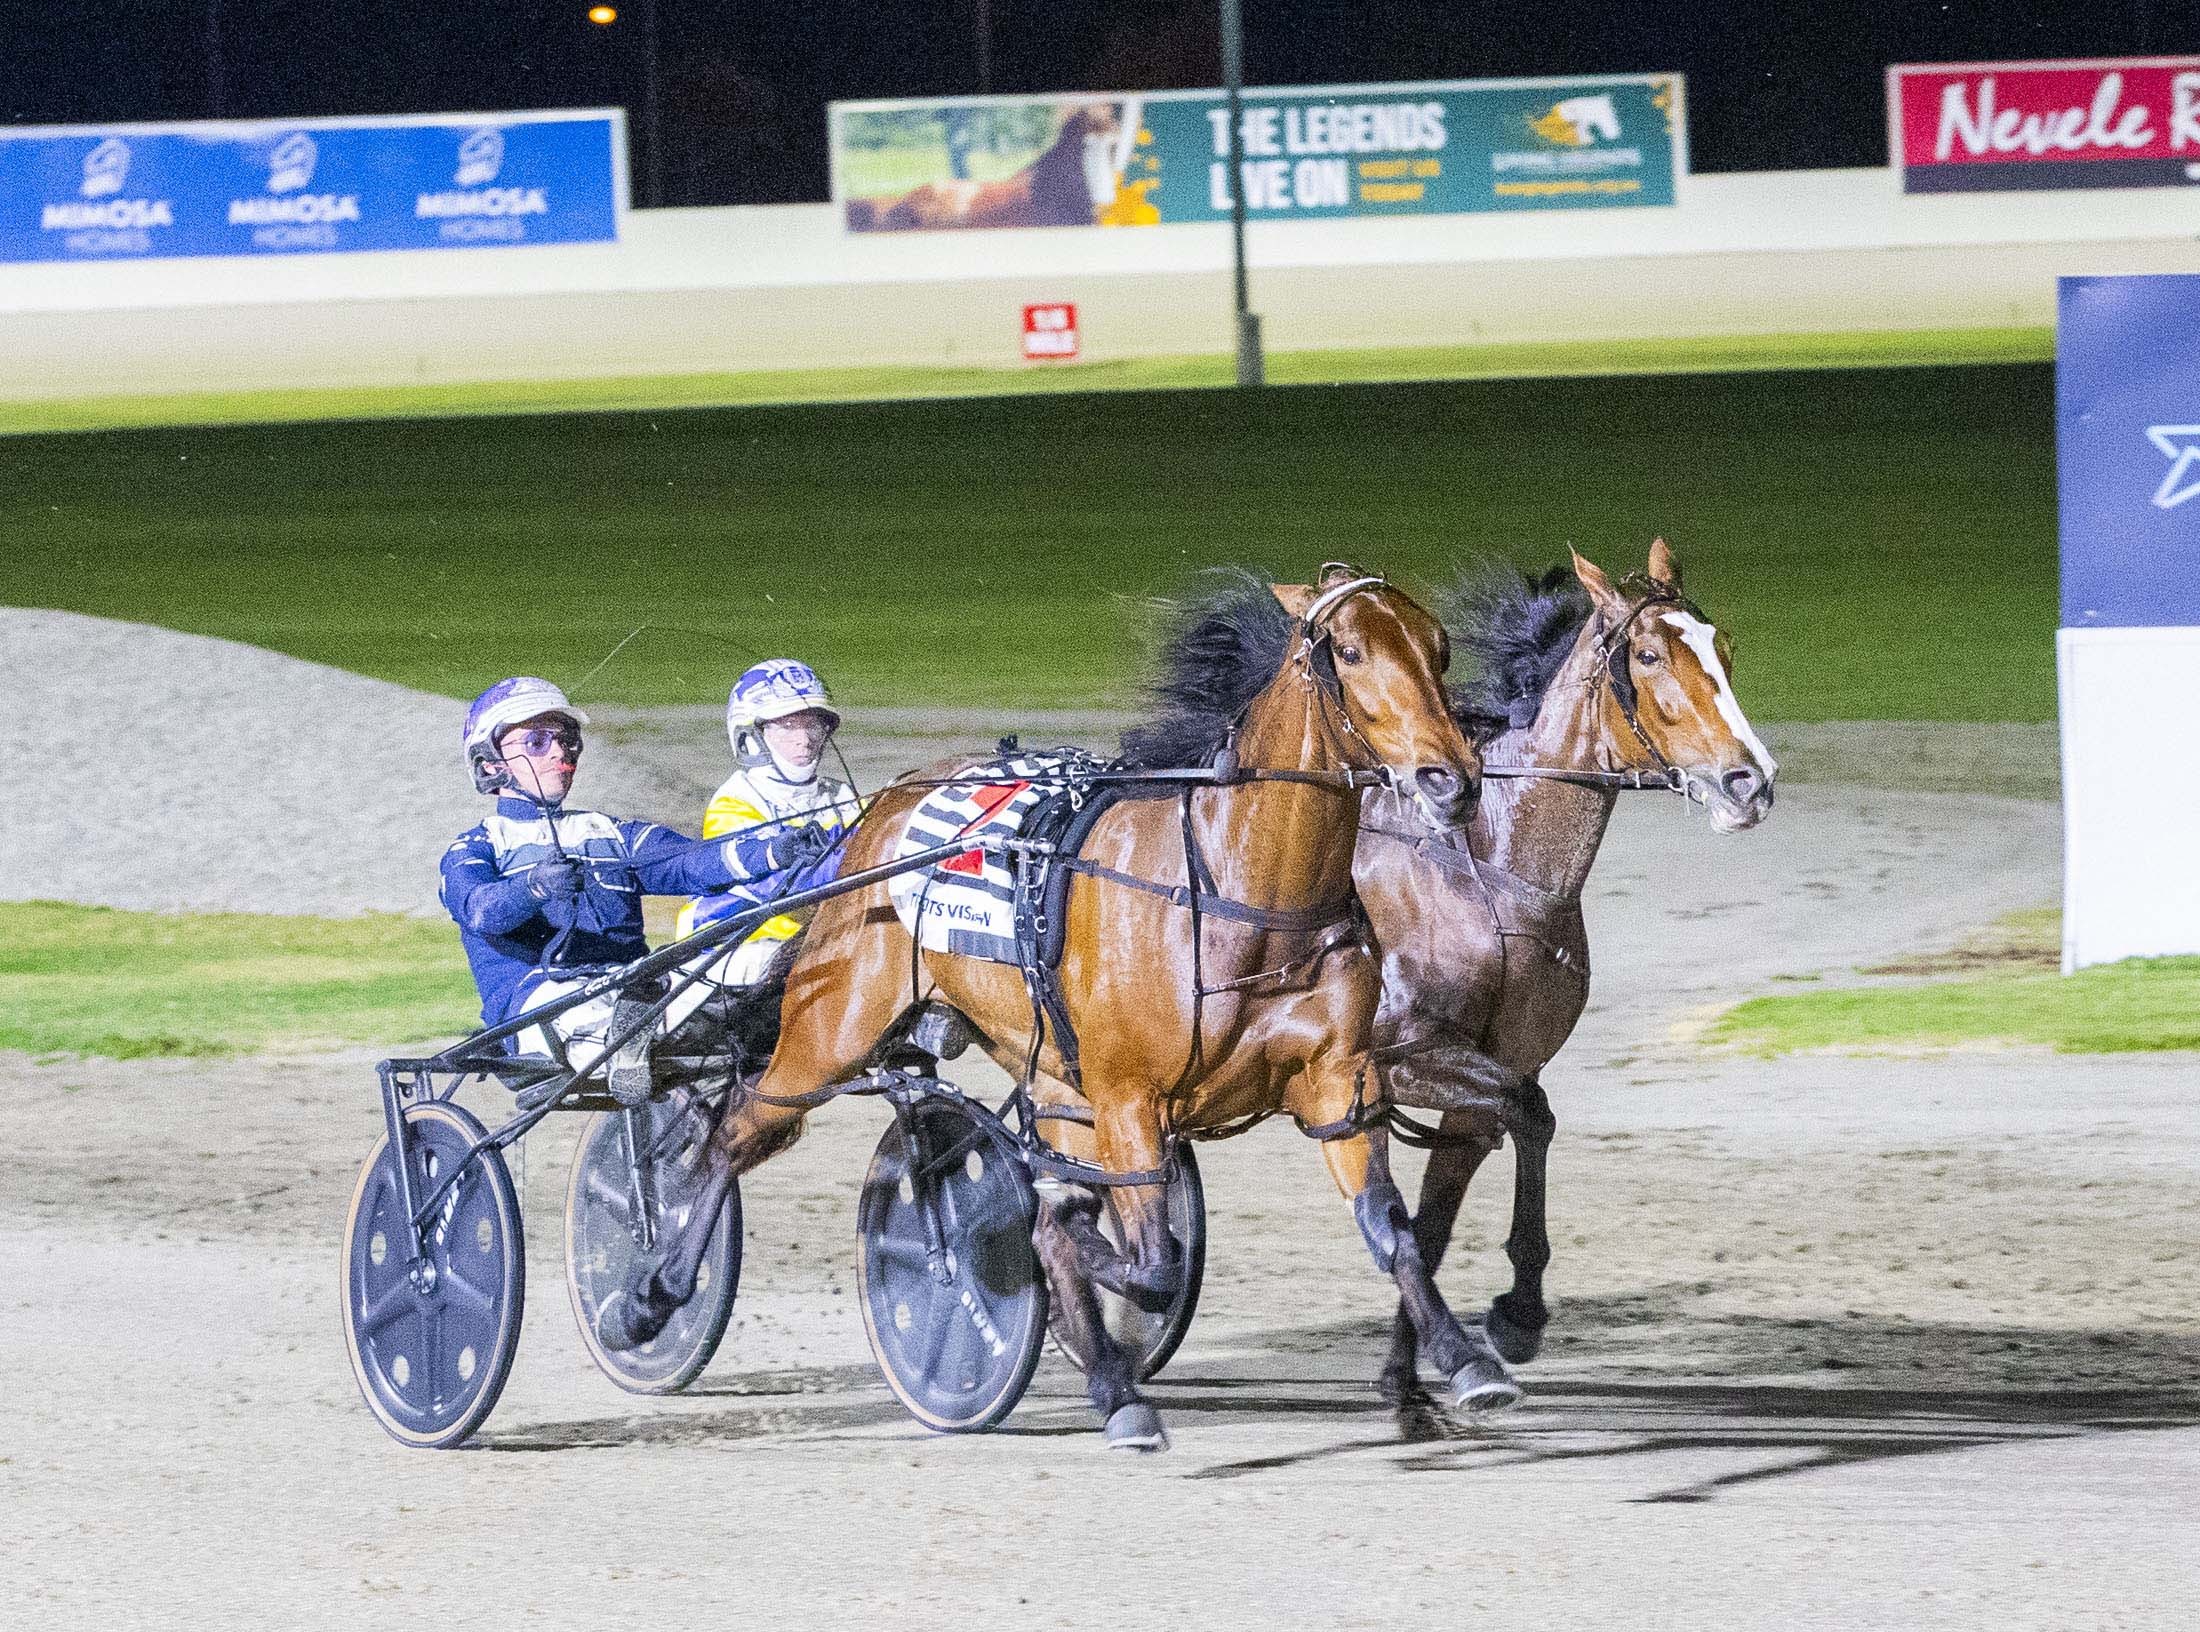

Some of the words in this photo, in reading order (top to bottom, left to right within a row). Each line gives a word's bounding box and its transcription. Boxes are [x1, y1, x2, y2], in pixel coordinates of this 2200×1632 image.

[1207, 107, 1282, 156] THE
[1285, 102, 1447, 154] LEGENDS
[1936, 72, 2155, 161] Nevele
[1209, 161, 1292, 209] LVE
[1294, 159, 1349, 208] ON
[42, 199, 173, 229] MIMOSA
[228, 194, 359, 224] MIMOSA
[416, 187, 547, 217] MIMOSA
[948, 904, 992, 927] VISIN
